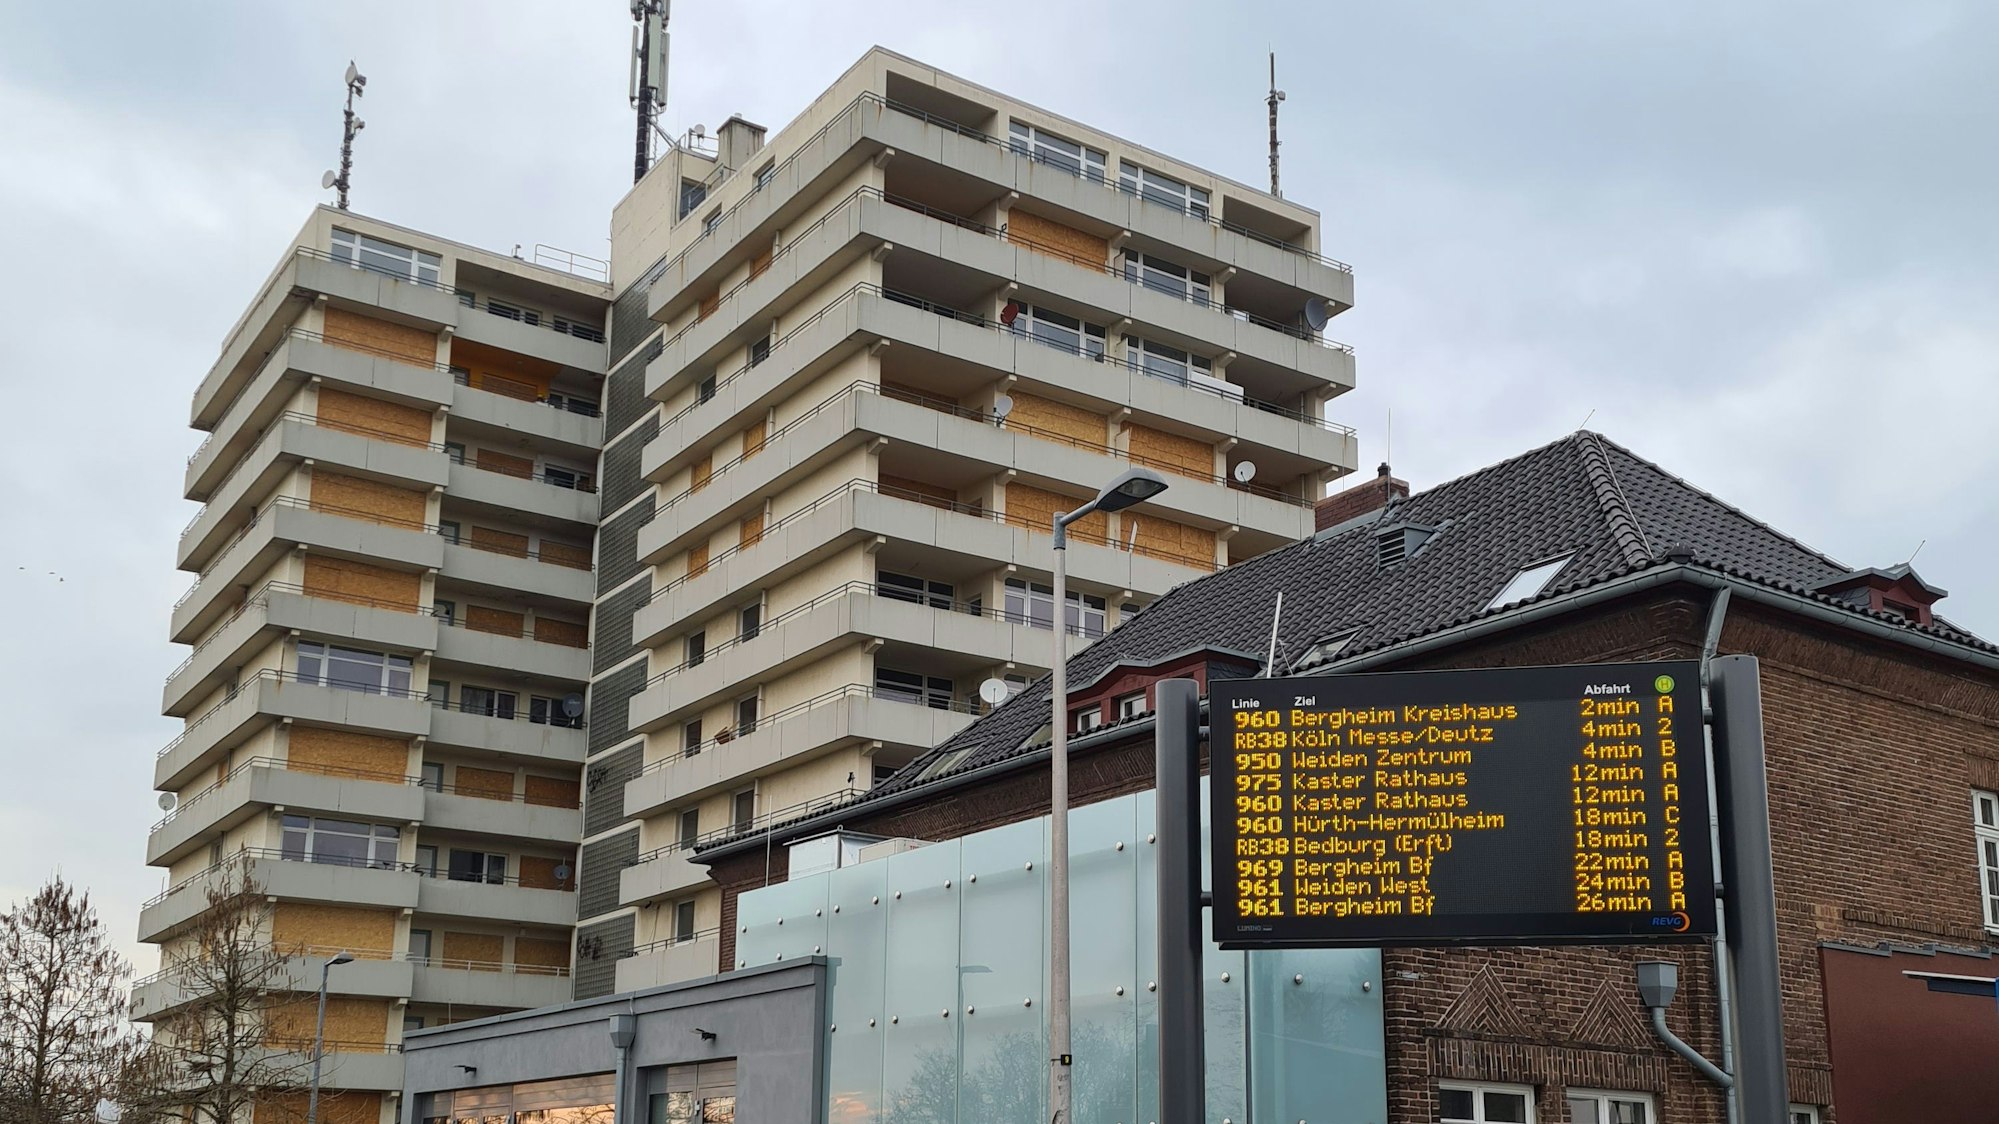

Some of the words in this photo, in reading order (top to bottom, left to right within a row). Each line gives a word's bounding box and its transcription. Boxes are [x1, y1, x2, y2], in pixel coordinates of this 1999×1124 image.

[1232, 698, 1260, 709] Linie
[1294, 695, 1316, 707] Ziel
[1584, 683, 1631, 695] Abfahrt
[1234, 710, 1281, 729] 960
[1291, 706, 1396, 731] Bergheim
[1404, 703, 1518, 723] Kreishaus
[1658, 695, 1674, 713] A
[1235, 731, 1288, 750] RB38
[1291, 727, 1341, 748] Köln
[1349, 724, 1494, 746] Messe/Deutz
[1657, 717, 1672, 735] 2
[1235, 752, 1282, 771] 950
[1292, 750, 1368, 769] Weiden
[1376, 747, 1472, 767] Zentrum
[1660, 739, 1676, 757] B
[1236, 773, 1282, 792] 975
[1292, 771, 1366, 790] Kaster
[1375, 769, 1468, 788] Rathaus
[1662, 761, 1678, 779] A
[1236, 794, 1282, 814] 960
[1293, 793, 1367, 812] Kaster
[1375, 790, 1469, 809] Rathaus
[1663, 783, 1679, 801] A
[1236, 816, 1283, 835] 960
[1293, 809, 1505, 833] Hürth-Hermülheim
[1664, 805, 1680, 824] C
[1236, 837, 1290, 856] RB38
[1294, 836, 1386, 859] Bedburg
[1395, 833, 1452, 857] (Erft)
[1664, 828, 1680, 847] 2
[1237, 859, 1284, 878] 969
[1294, 856, 1401, 880] Bergheim
[1409, 854, 1434, 878] Bf
[1668, 850, 1683, 869] A
[1237, 878, 1284, 897] 961
[1295, 877, 1372, 899] Weiden
[1380, 875, 1431, 894] West
[1669, 871, 1685, 890] B
[1238, 898, 1285, 917] 961
[1295, 896, 1402, 917] Bergheim
[1410, 895, 1436, 916] Bf
[1670, 891, 1686, 910] A
[1651, 917, 1681, 926] REVG
